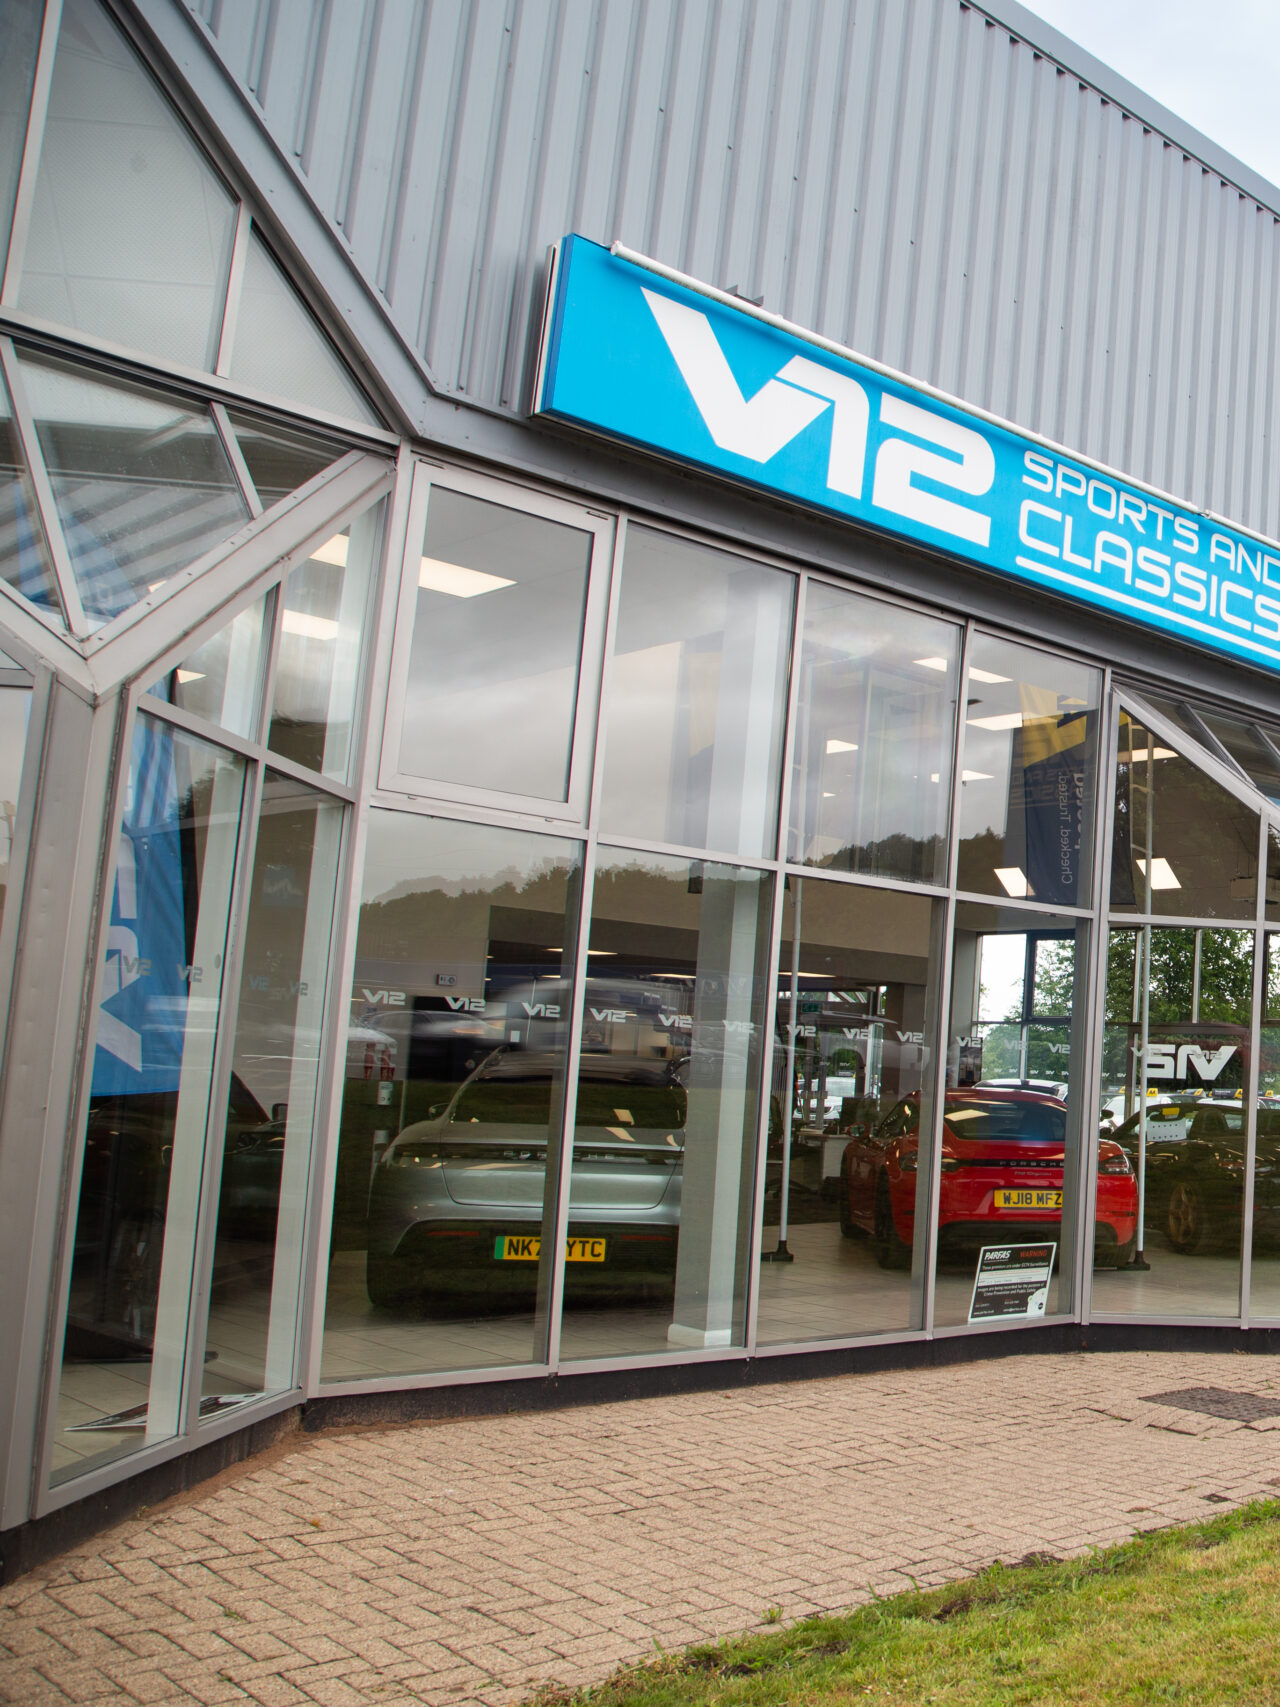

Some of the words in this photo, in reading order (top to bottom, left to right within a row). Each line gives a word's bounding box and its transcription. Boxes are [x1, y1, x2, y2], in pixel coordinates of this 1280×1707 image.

[640, 286, 996, 548] V12
[1022, 450, 1199, 555] SPORTS
[362, 989, 407, 1006] V12
[444, 996, 486, 1012] V12
[521, 1002, 561, 1018] V12
[590, 1008, 626, 1023] V12
[658, 1014, 693, 1028] V12
[896, 1031, 924, 1043] V12
[956, 1036, 983, 1048] V12
[1003, 1192, 1033, 1205] WJ18
[1036, 1192, 1063, 1206] MFZ
[506, 1239, 541, 1257] NK7
[566, 1240, 603, 1257] YTC
